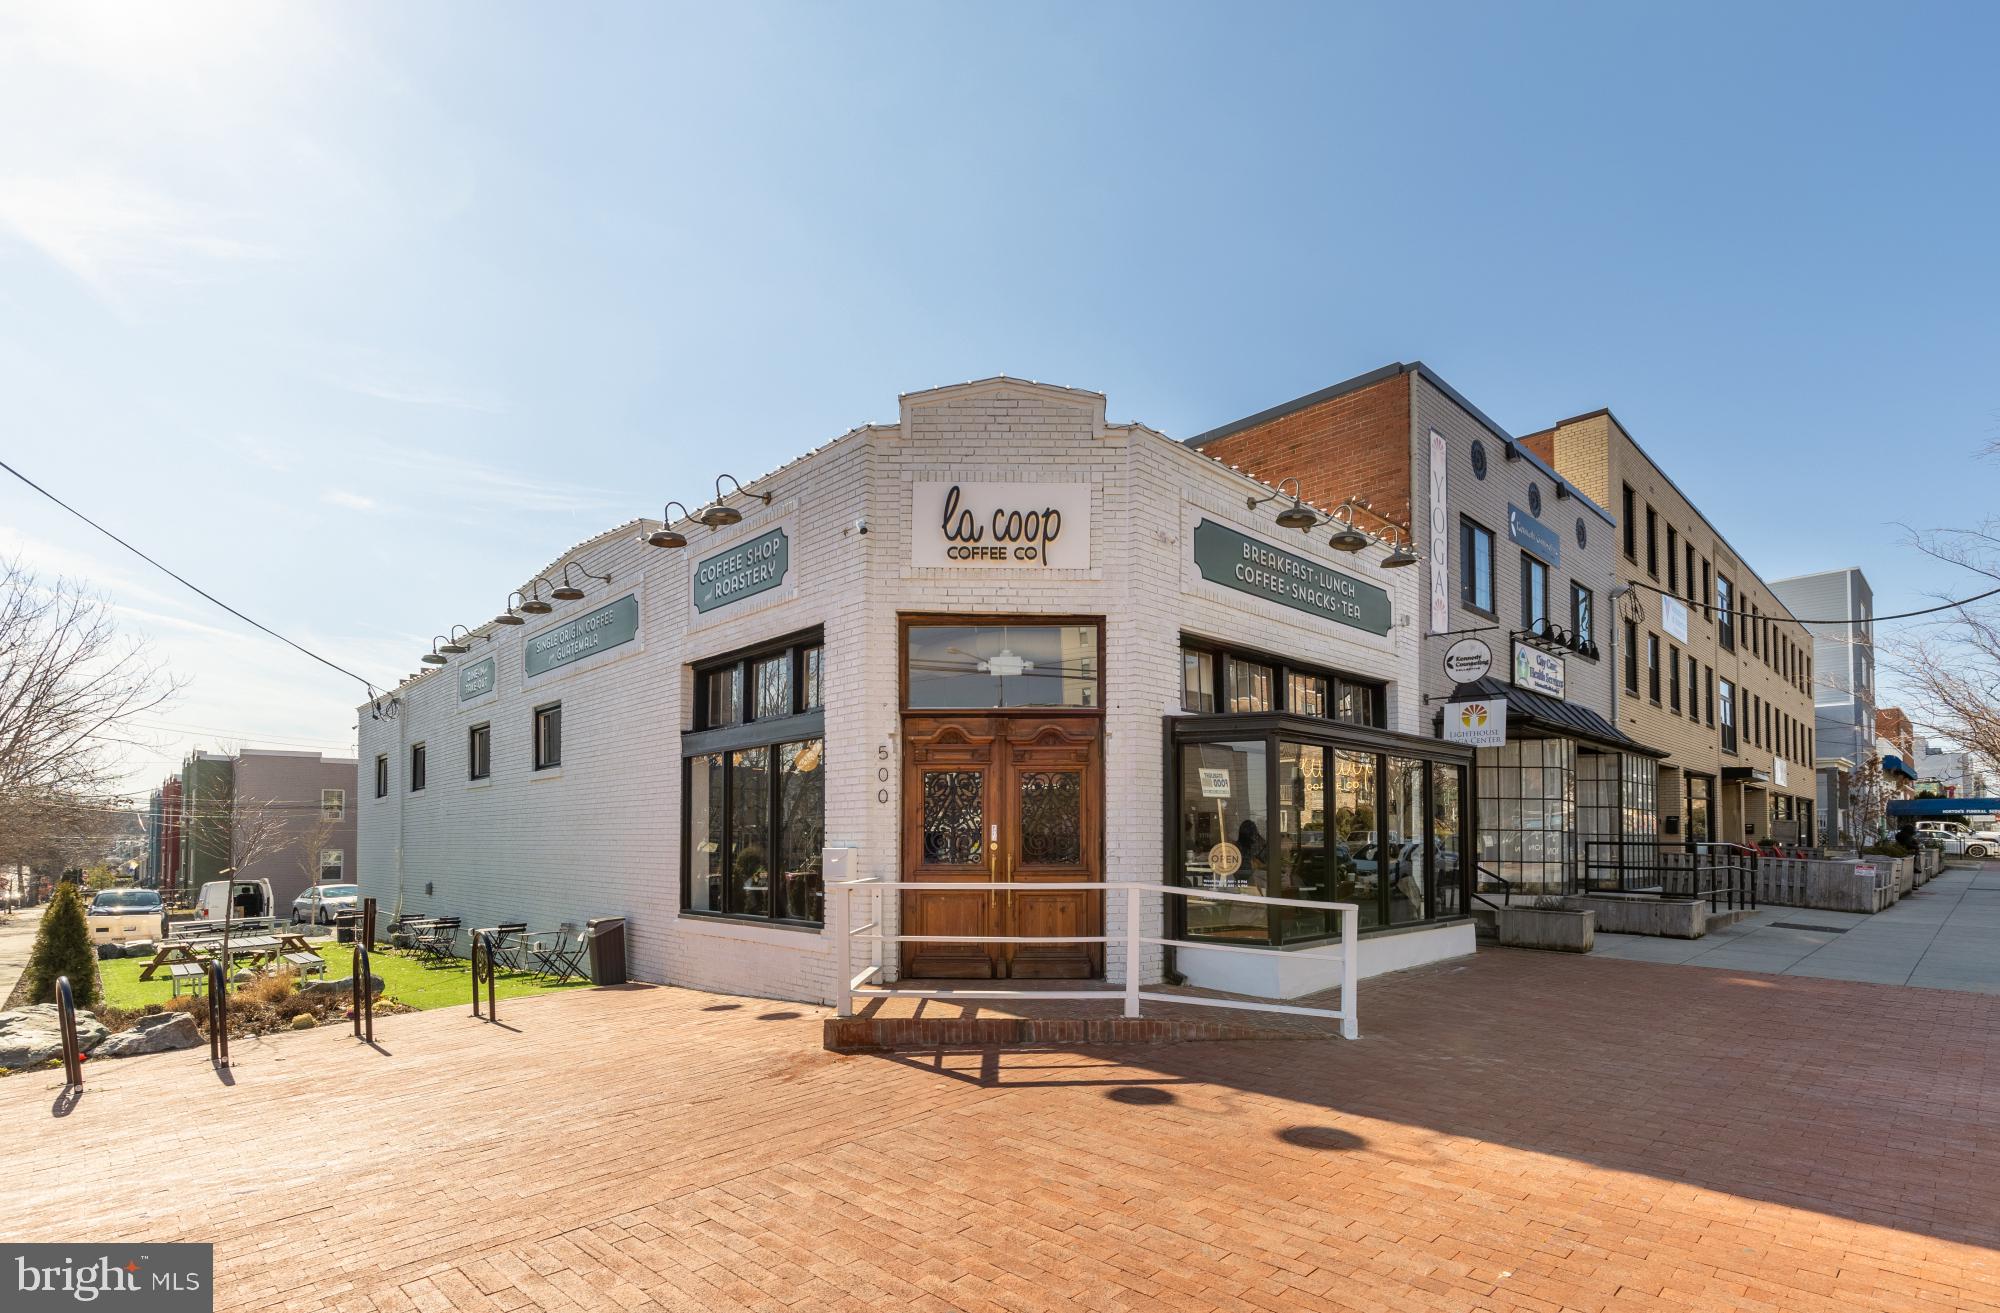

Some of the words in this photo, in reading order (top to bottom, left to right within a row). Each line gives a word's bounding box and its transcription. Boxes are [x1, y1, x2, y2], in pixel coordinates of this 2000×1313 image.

[942, 485, 984, 543] la
[991, 507, 1061, 566] coop
[1433, 471, 1445, 597] YOGA
[700, 553, 743, 585] COFFEE
[747, 538, 780, 566] SHOP
[947, 546, 1007, 560] COFFEE
[1014, 546, 1037, 560] CO
[1243, 542, 1314, 584] BREAKFAST
[1319, 571, 1355, 599] LUNCH
[715, 560, 776, 599] ROASTERY
[1235, 563, 1285, 594] COFFEE
[1291, 583, 1336, 612] SNACKS
[1341, 600, 1361, 620] TEA
[536, 633, 558, 655] SINGLE
[559, 624, 583, 645] ORIGIN
[585, 609, 614, 633] COFFEE
[556, 633, 599, 661] GUATEMALA
[1450, 729, 1499, 739] LIGHTHOUSE
[1470, 736, 1502, 744] CENTER
[878, 745, 889, 804] 500
[1211, 854, 1240, 864] OPEN
